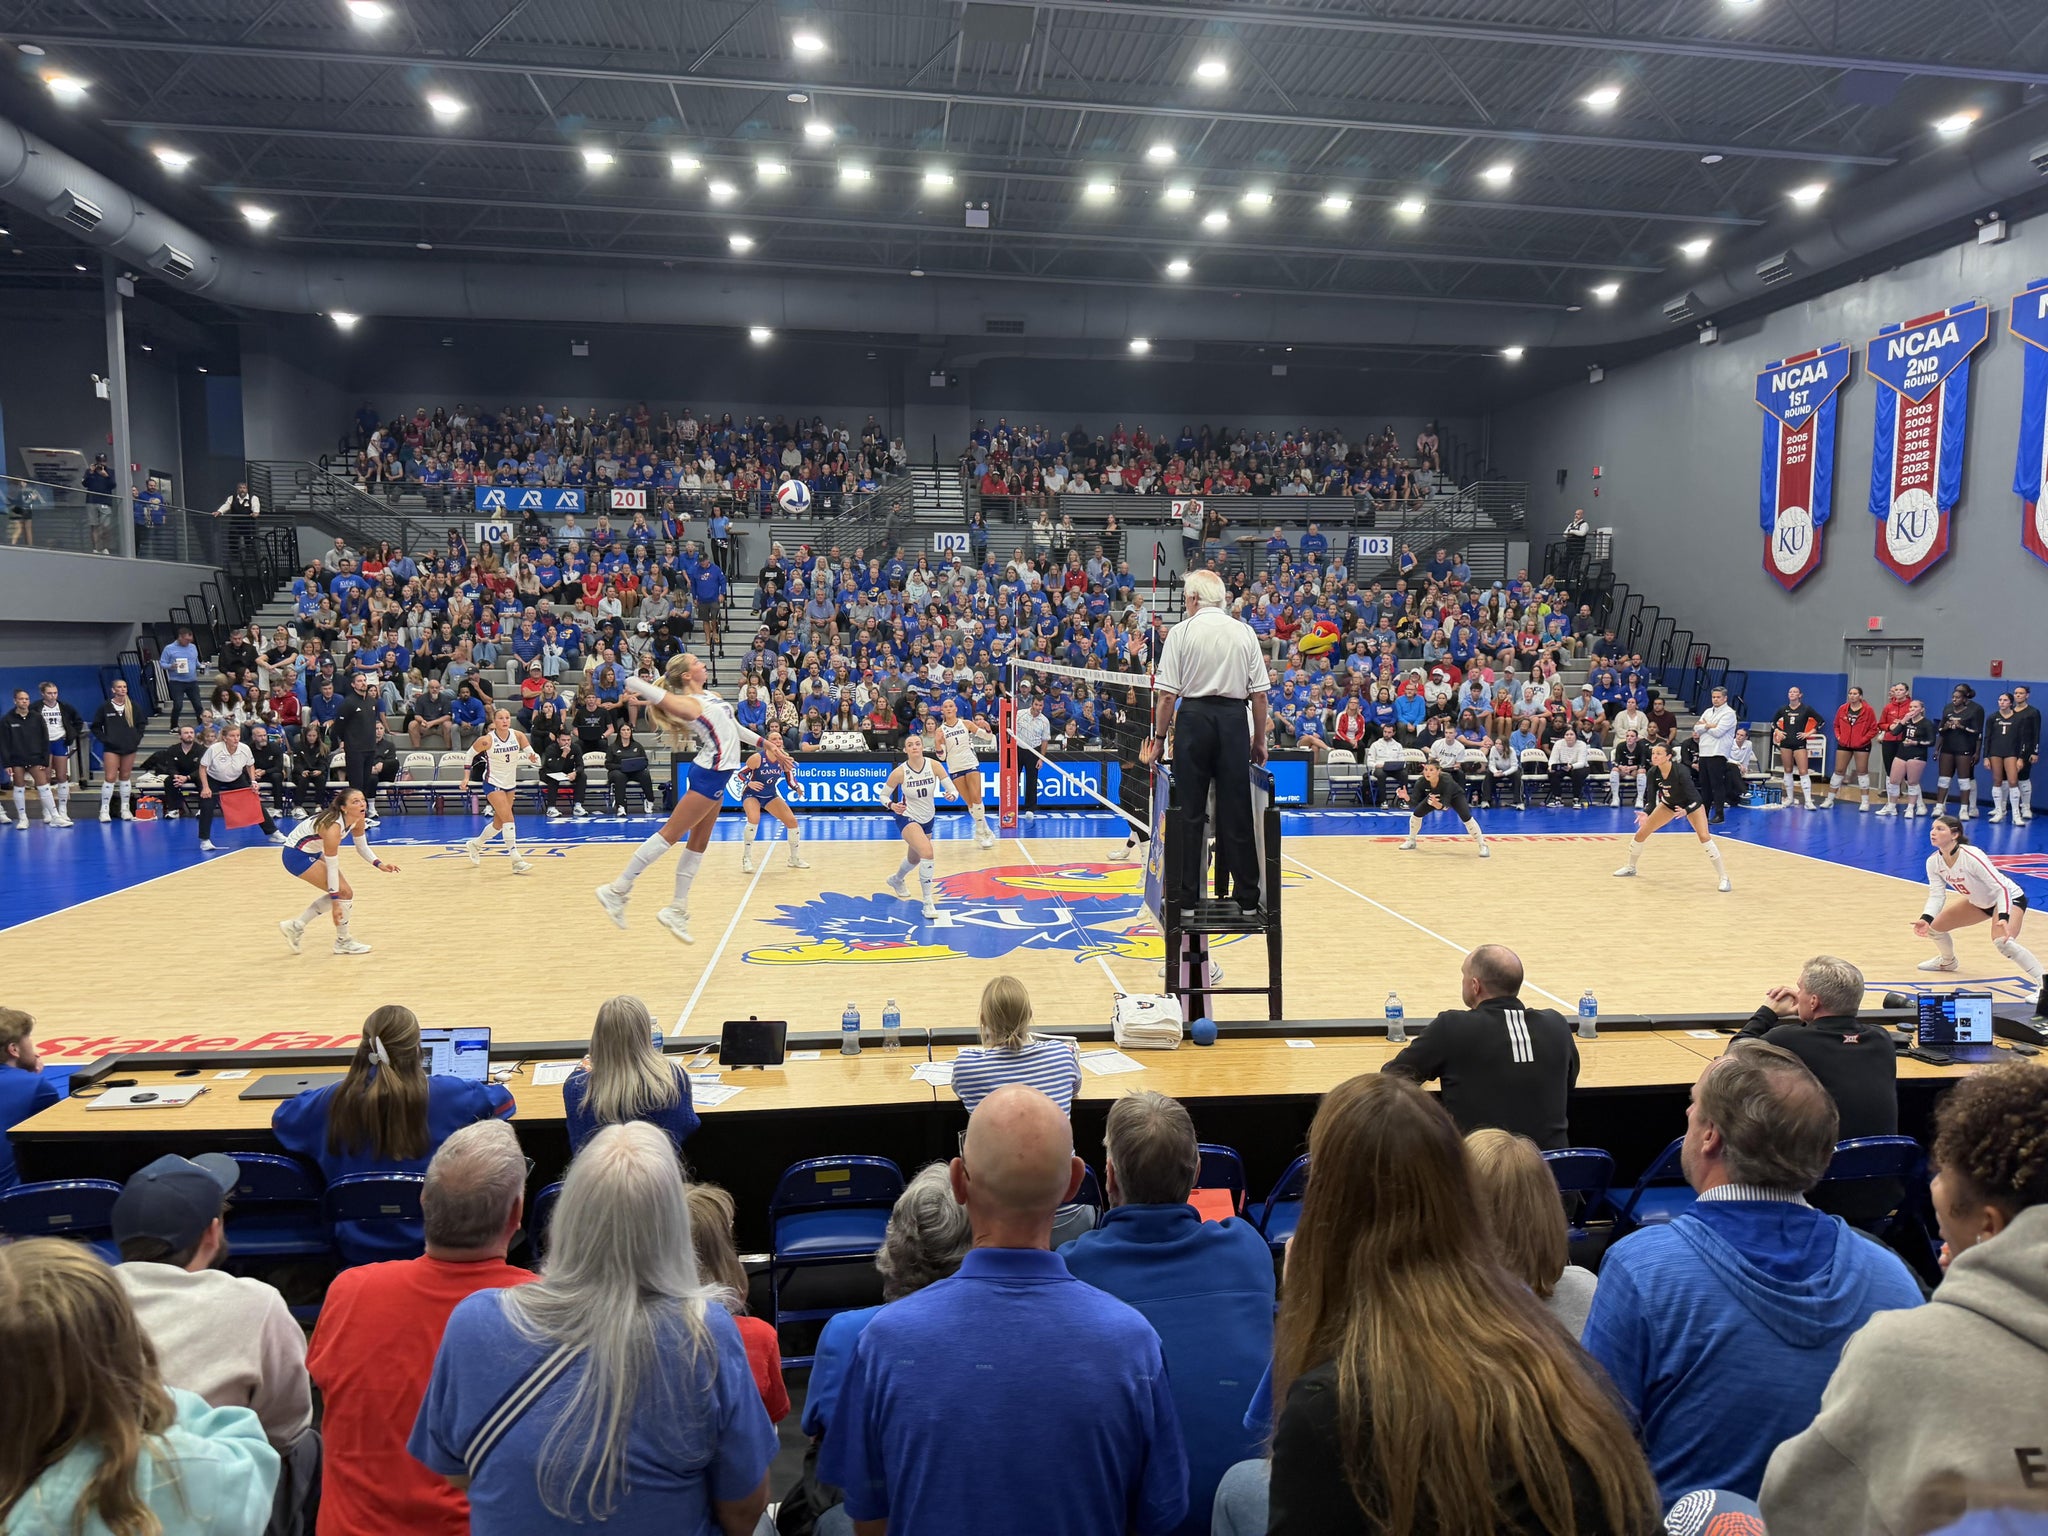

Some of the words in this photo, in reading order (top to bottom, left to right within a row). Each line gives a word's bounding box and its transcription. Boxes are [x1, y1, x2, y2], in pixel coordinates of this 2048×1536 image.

[1887, 322, 1960, 361] NCAA
[1906, 356, 1939, 377] 2ND
[1771, 361, 1828, 393] NCAA
[1904, 373, 1939, 389] ROUND
[1788, 390, 1809, 407] 1ST
[1784, 405, 1811, 418] ROUND
[1905, 404, 1933, 417] 2003
[1904, 416, 1932, 429] 2004
[1786, 433, 1808, 444] 2005
[1905, 427, 1930, 440] 2012
[1786, 444, 1807, 454] 2014
[1904, 439, 1930, 452] 2016
[1786, 454, 1806, 465] 2017
[1902, 451, 1930, 464] 2022
[1901, 462, 1929, 475] 2023
[1900, 473, 1929, 486] 2024
[613, 492, 645, 506] 201
[1895, 508, 1928, 543] KU
[937, 536, 965, 550] 102
[1363, 539, 1389, 554] 103
[1779, 526, 1805, 555] KU
[954, 737, 959, 745] 1
[407, 753, 432, 761] KANSAS
[505, 754, 511, 763] 3
[792, 768, 836, 777] BlueCross
[840, 768, 887, 777] BlueShield
[916, 788, 928, 798] 10
